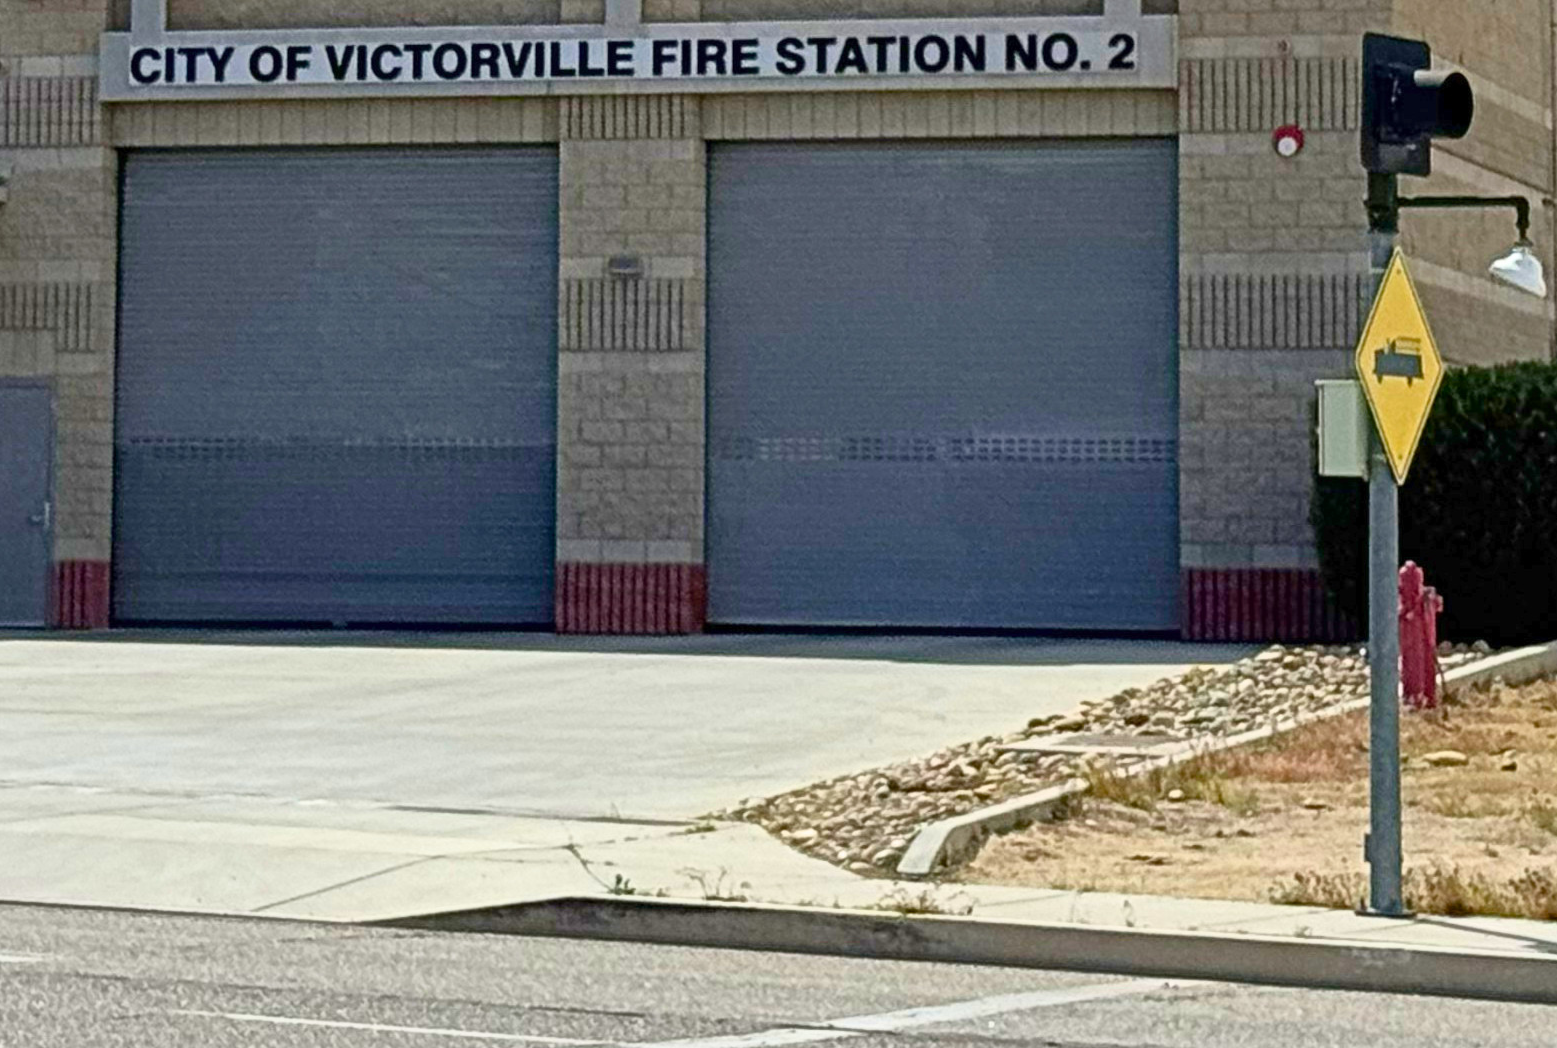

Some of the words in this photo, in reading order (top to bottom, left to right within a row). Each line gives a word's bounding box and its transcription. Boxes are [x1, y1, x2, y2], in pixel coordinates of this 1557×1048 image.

[130, 46, 235, 86] CITY
[249, 44, 312, 83] OF
[325, 40, 635, 82] VICTORVILLE
[652, 38, 760, 77] FIRE
[775, 34, 986, 74] STATION
[1005, 32, 1091, 72] NO.
[1107, 33, 1136, 71] 2
